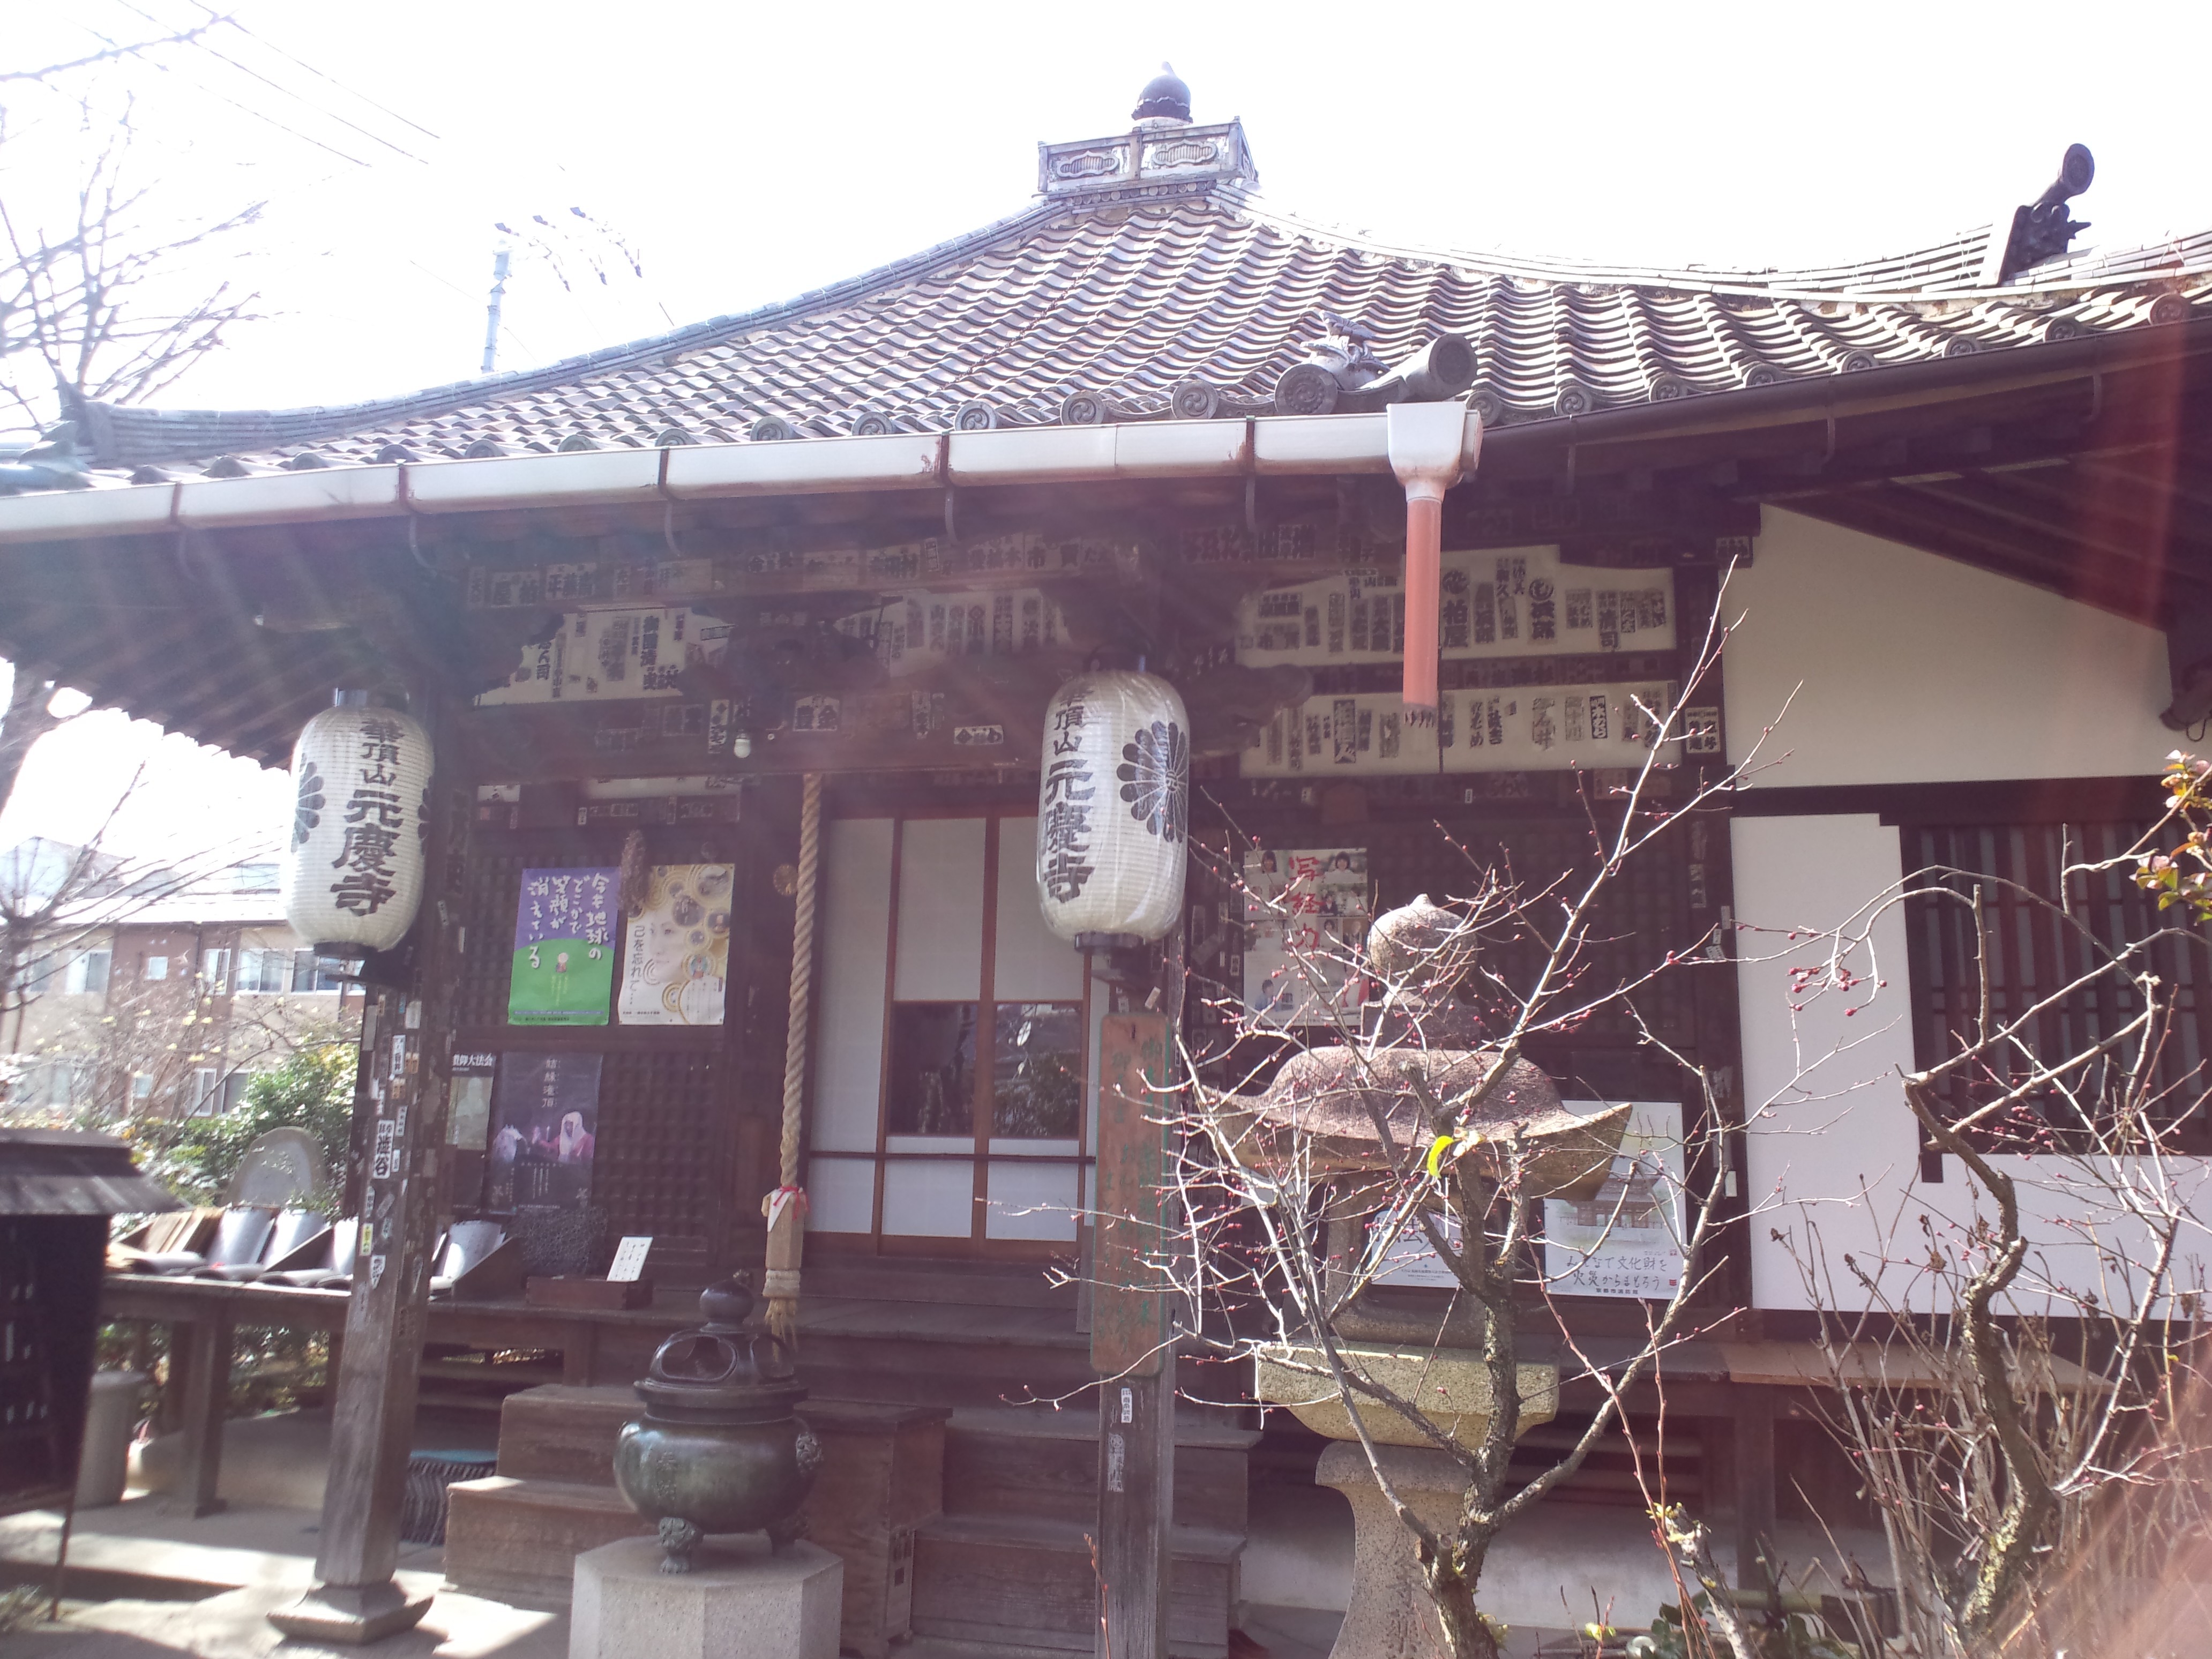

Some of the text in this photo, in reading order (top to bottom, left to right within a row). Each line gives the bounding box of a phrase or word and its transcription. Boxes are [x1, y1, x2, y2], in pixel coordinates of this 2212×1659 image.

[331, 719, 404, 916] 華頂山元慶寺
[527, 877, 550, 969] 消えている
[549, 875, 571, 930] 笑顔が
[569, 875, 591, 935] どこかで
[585, 872, 610, 960] 今も地球の
[1573, 1270, 1661, 1290] 火災からまもろう
